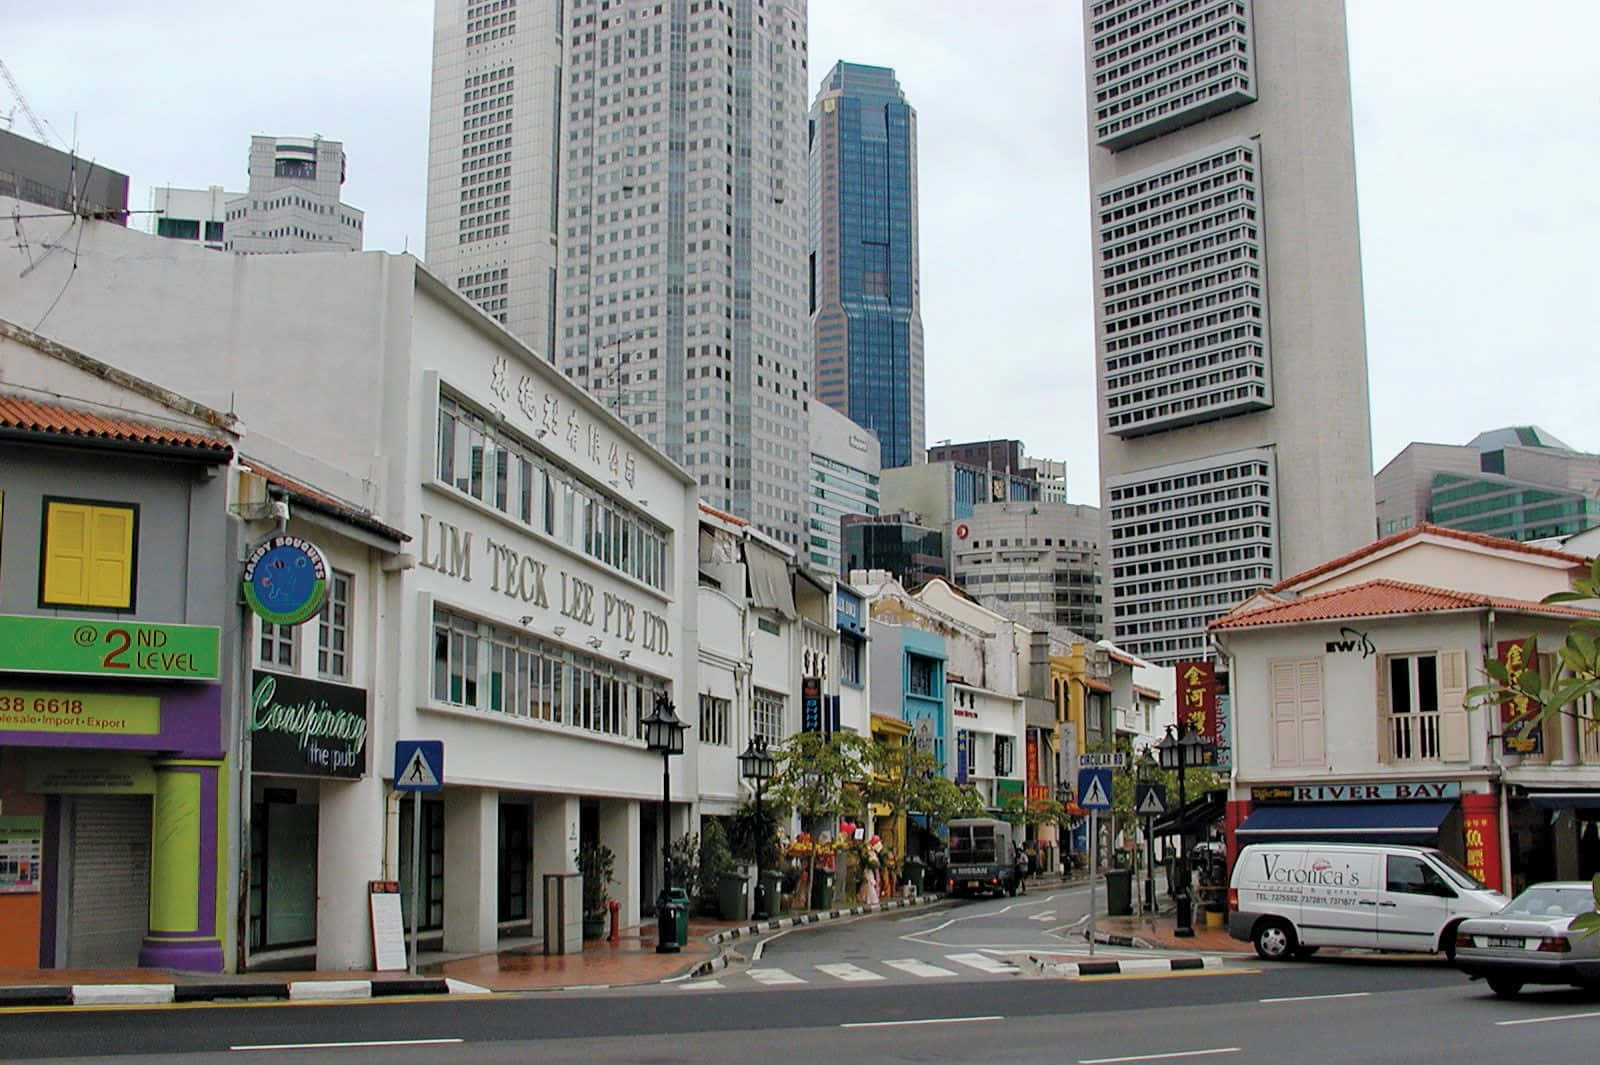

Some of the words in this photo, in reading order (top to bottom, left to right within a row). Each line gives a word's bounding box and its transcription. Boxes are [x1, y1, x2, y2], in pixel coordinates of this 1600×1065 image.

[244, 541, 271, 581] CANDY
[276, 536, 325, 579] BOUQUETS
[418, 513, 473, 582] LIM
[486, 537, 549, 609] TECK
[560, 571, 595, 626] LEE
[603, 591, 636, 643] PTE
[643, 610, 673, 657] LTD.
[137, 651, 199, 672] LEVEL
[33, 698, 82, 714] 6618
[252, 675, 368, 754] Conspiracy
[310, 741, 329, 765] the
[334, 743, 356, 770] pub
[1298, 785, 1380, 799] RIVER
[1395, 783, 1447, 798] BAY
[1262, 853, 1360, 887] Veronica's
